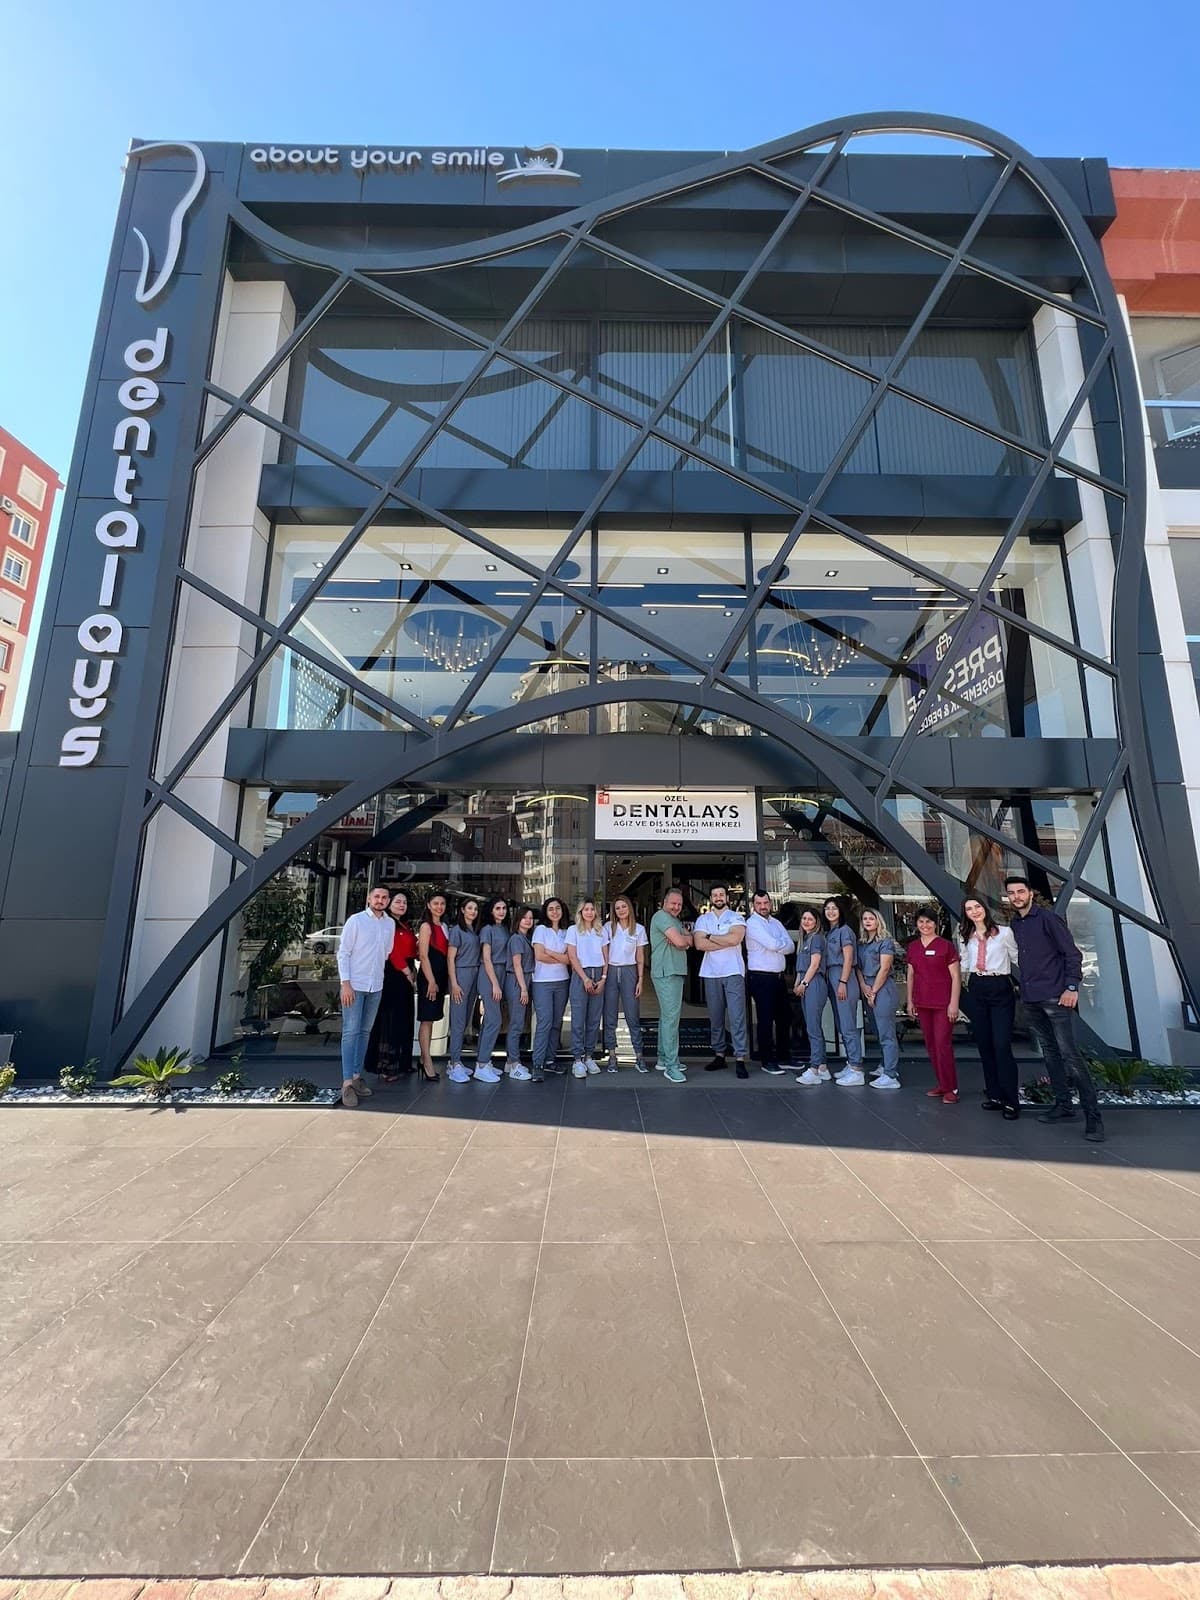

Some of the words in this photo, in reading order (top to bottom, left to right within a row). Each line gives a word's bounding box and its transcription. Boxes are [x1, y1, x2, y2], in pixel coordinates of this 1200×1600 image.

[250, 147, 339, 164] about
[350, 148, 423, 169] your
[431, 148, 505, 166] smile
[613, 804, 739, 818] DENTALAYS
